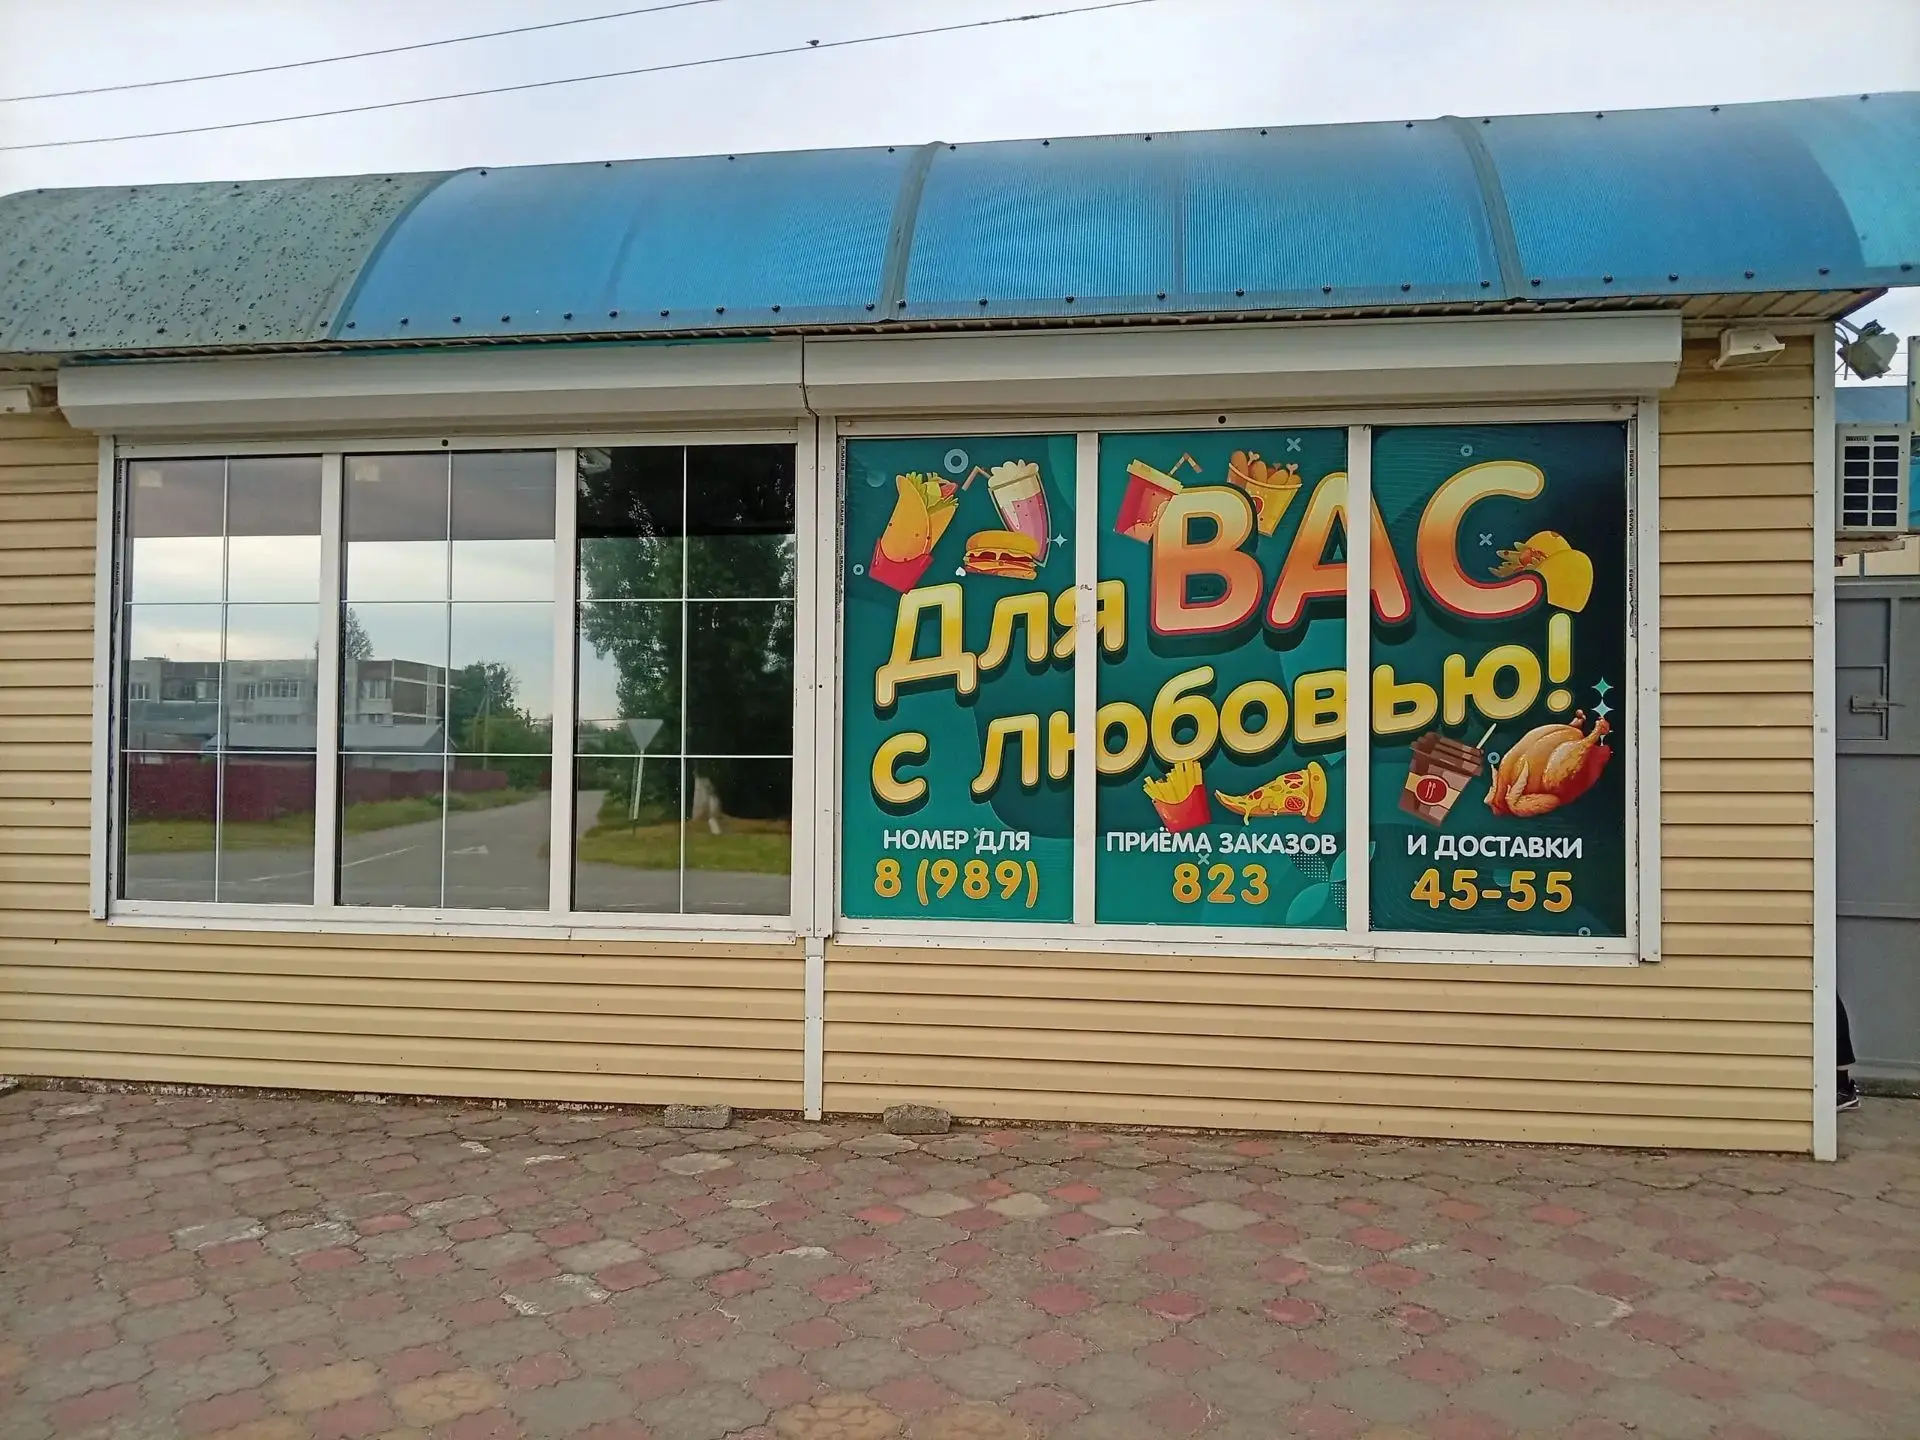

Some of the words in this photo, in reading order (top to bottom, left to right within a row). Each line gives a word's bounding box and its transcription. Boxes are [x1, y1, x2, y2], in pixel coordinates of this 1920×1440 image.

[875, 579, 1128, 708] Для
[1150, 460, 1545, 636] ВАС
[871, 731, 929, 804] с
[969, 612, 1573, 796] любовью!
[874, 858, 902, 898] 8
[916, 858, 1039, 909] (989)
[1172, 862, 1270, 904] 823
[1410, 867, 1574, 912] 45-55
[883, 829, 969, 851] НОМЕР
[975, 831, 1031, 855] ДЛЯ
[1106, 827, 1212, 853] ПРИЁМА
[1219, 832, 1337, 855] ЗАКАЗОВ
[1407, 834, 1427, 856] И
[1434, 835, 1583, 860] ДОСТАВКИ
